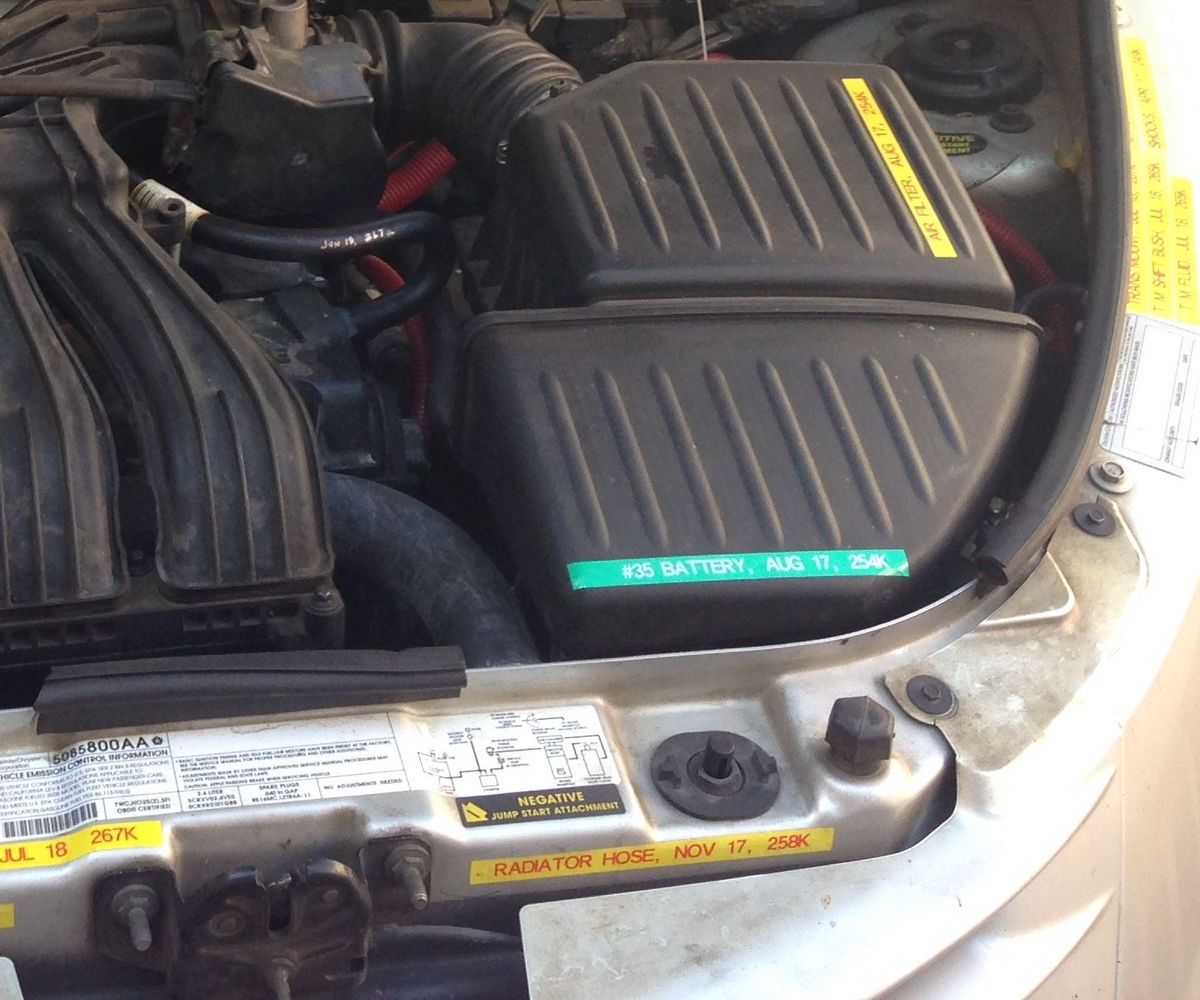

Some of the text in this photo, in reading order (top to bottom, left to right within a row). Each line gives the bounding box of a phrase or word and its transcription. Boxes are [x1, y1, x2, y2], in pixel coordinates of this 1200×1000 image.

[872, 123, 887, 136] 17,
[881, 144, 903, 167] AUG
[622, 553, 887, 579] #35 BATTERY, AUG 17, 254K
[27, 765, 66, 779] EMISSION
[68, 755, 106, 770] CONTROL
[109, 750, 168, 761] INFORMATION
[491, 801, 619, 821] JUMP START ATTACHMENT
[517, 791, 585, 807] NEGATIVE
[45, 841, 68, 858] 18
[89, 826, 138, 846] 267K
[494, 834, 810, 878] RADIATOR HOSE, NOV 17, 258K
